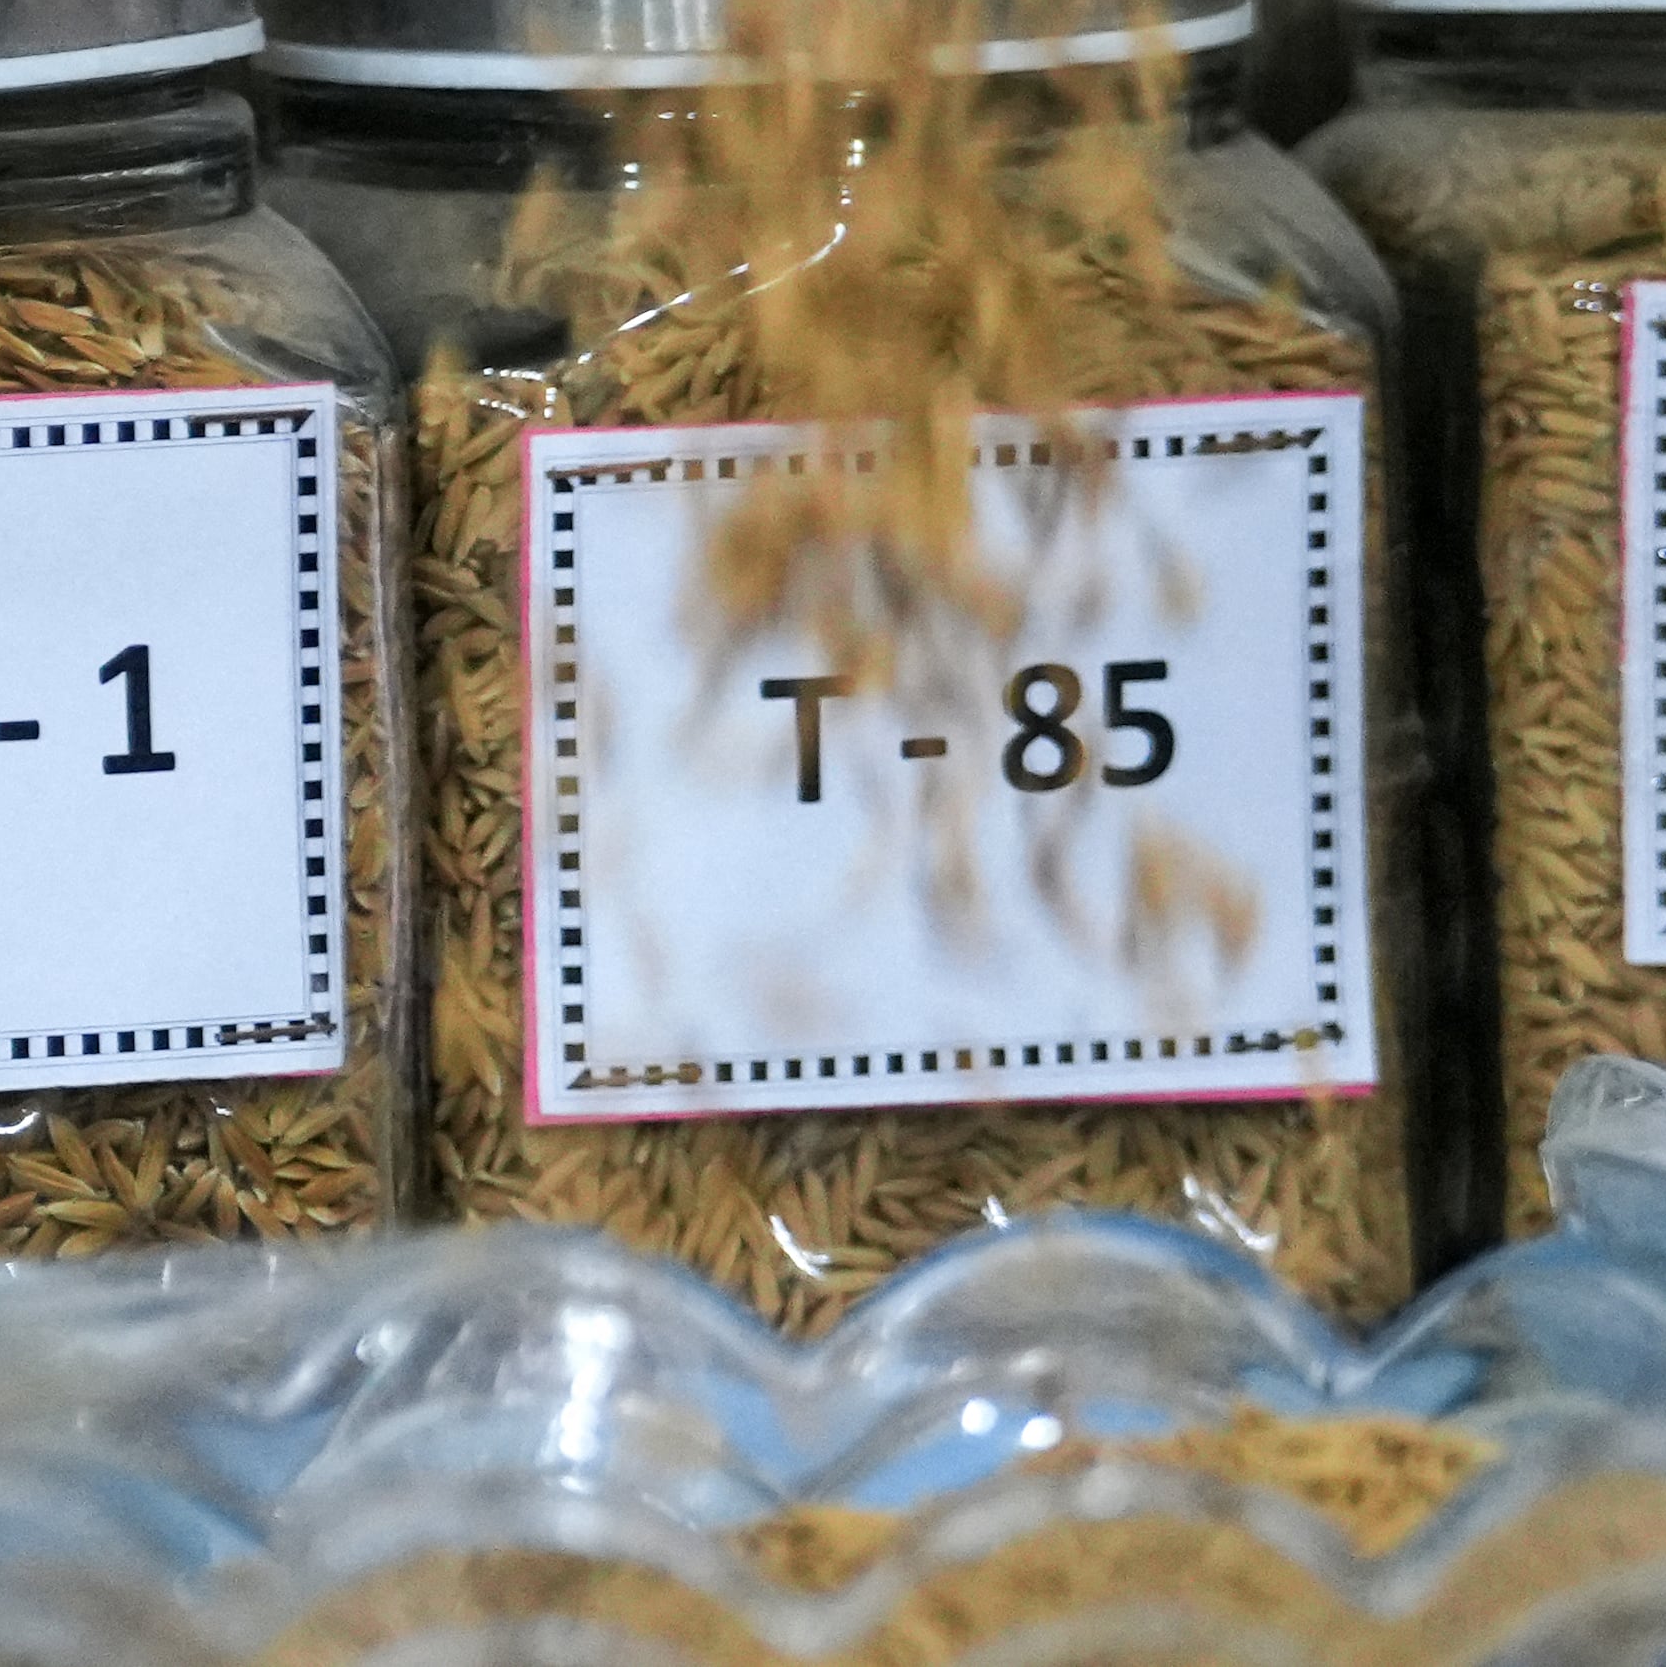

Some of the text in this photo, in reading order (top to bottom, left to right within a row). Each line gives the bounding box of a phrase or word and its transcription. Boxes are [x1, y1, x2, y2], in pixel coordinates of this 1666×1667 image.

[99, 644, 176, 775] 1
[760, 676, 853, 803] T
[1002, 659, 1176, 793] 85
